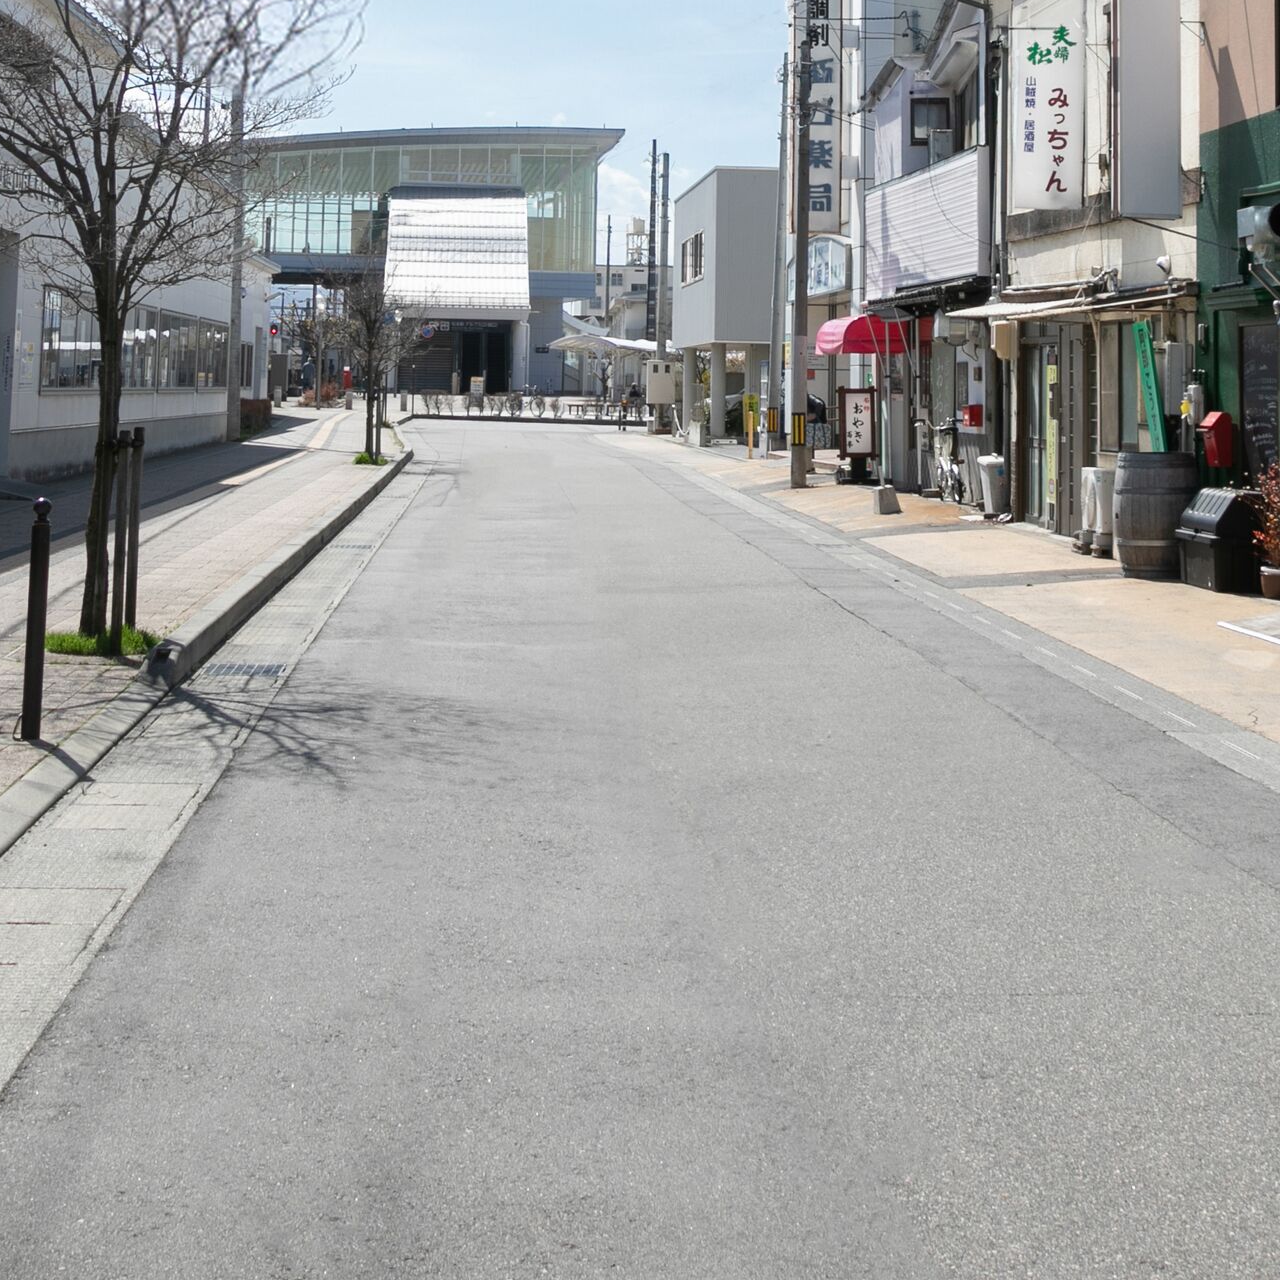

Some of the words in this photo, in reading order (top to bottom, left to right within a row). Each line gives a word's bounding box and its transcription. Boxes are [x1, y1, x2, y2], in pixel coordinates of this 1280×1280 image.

[1045, 87, 1070, 193] みっちゃん
[851, 402, 865, 444] おやき
